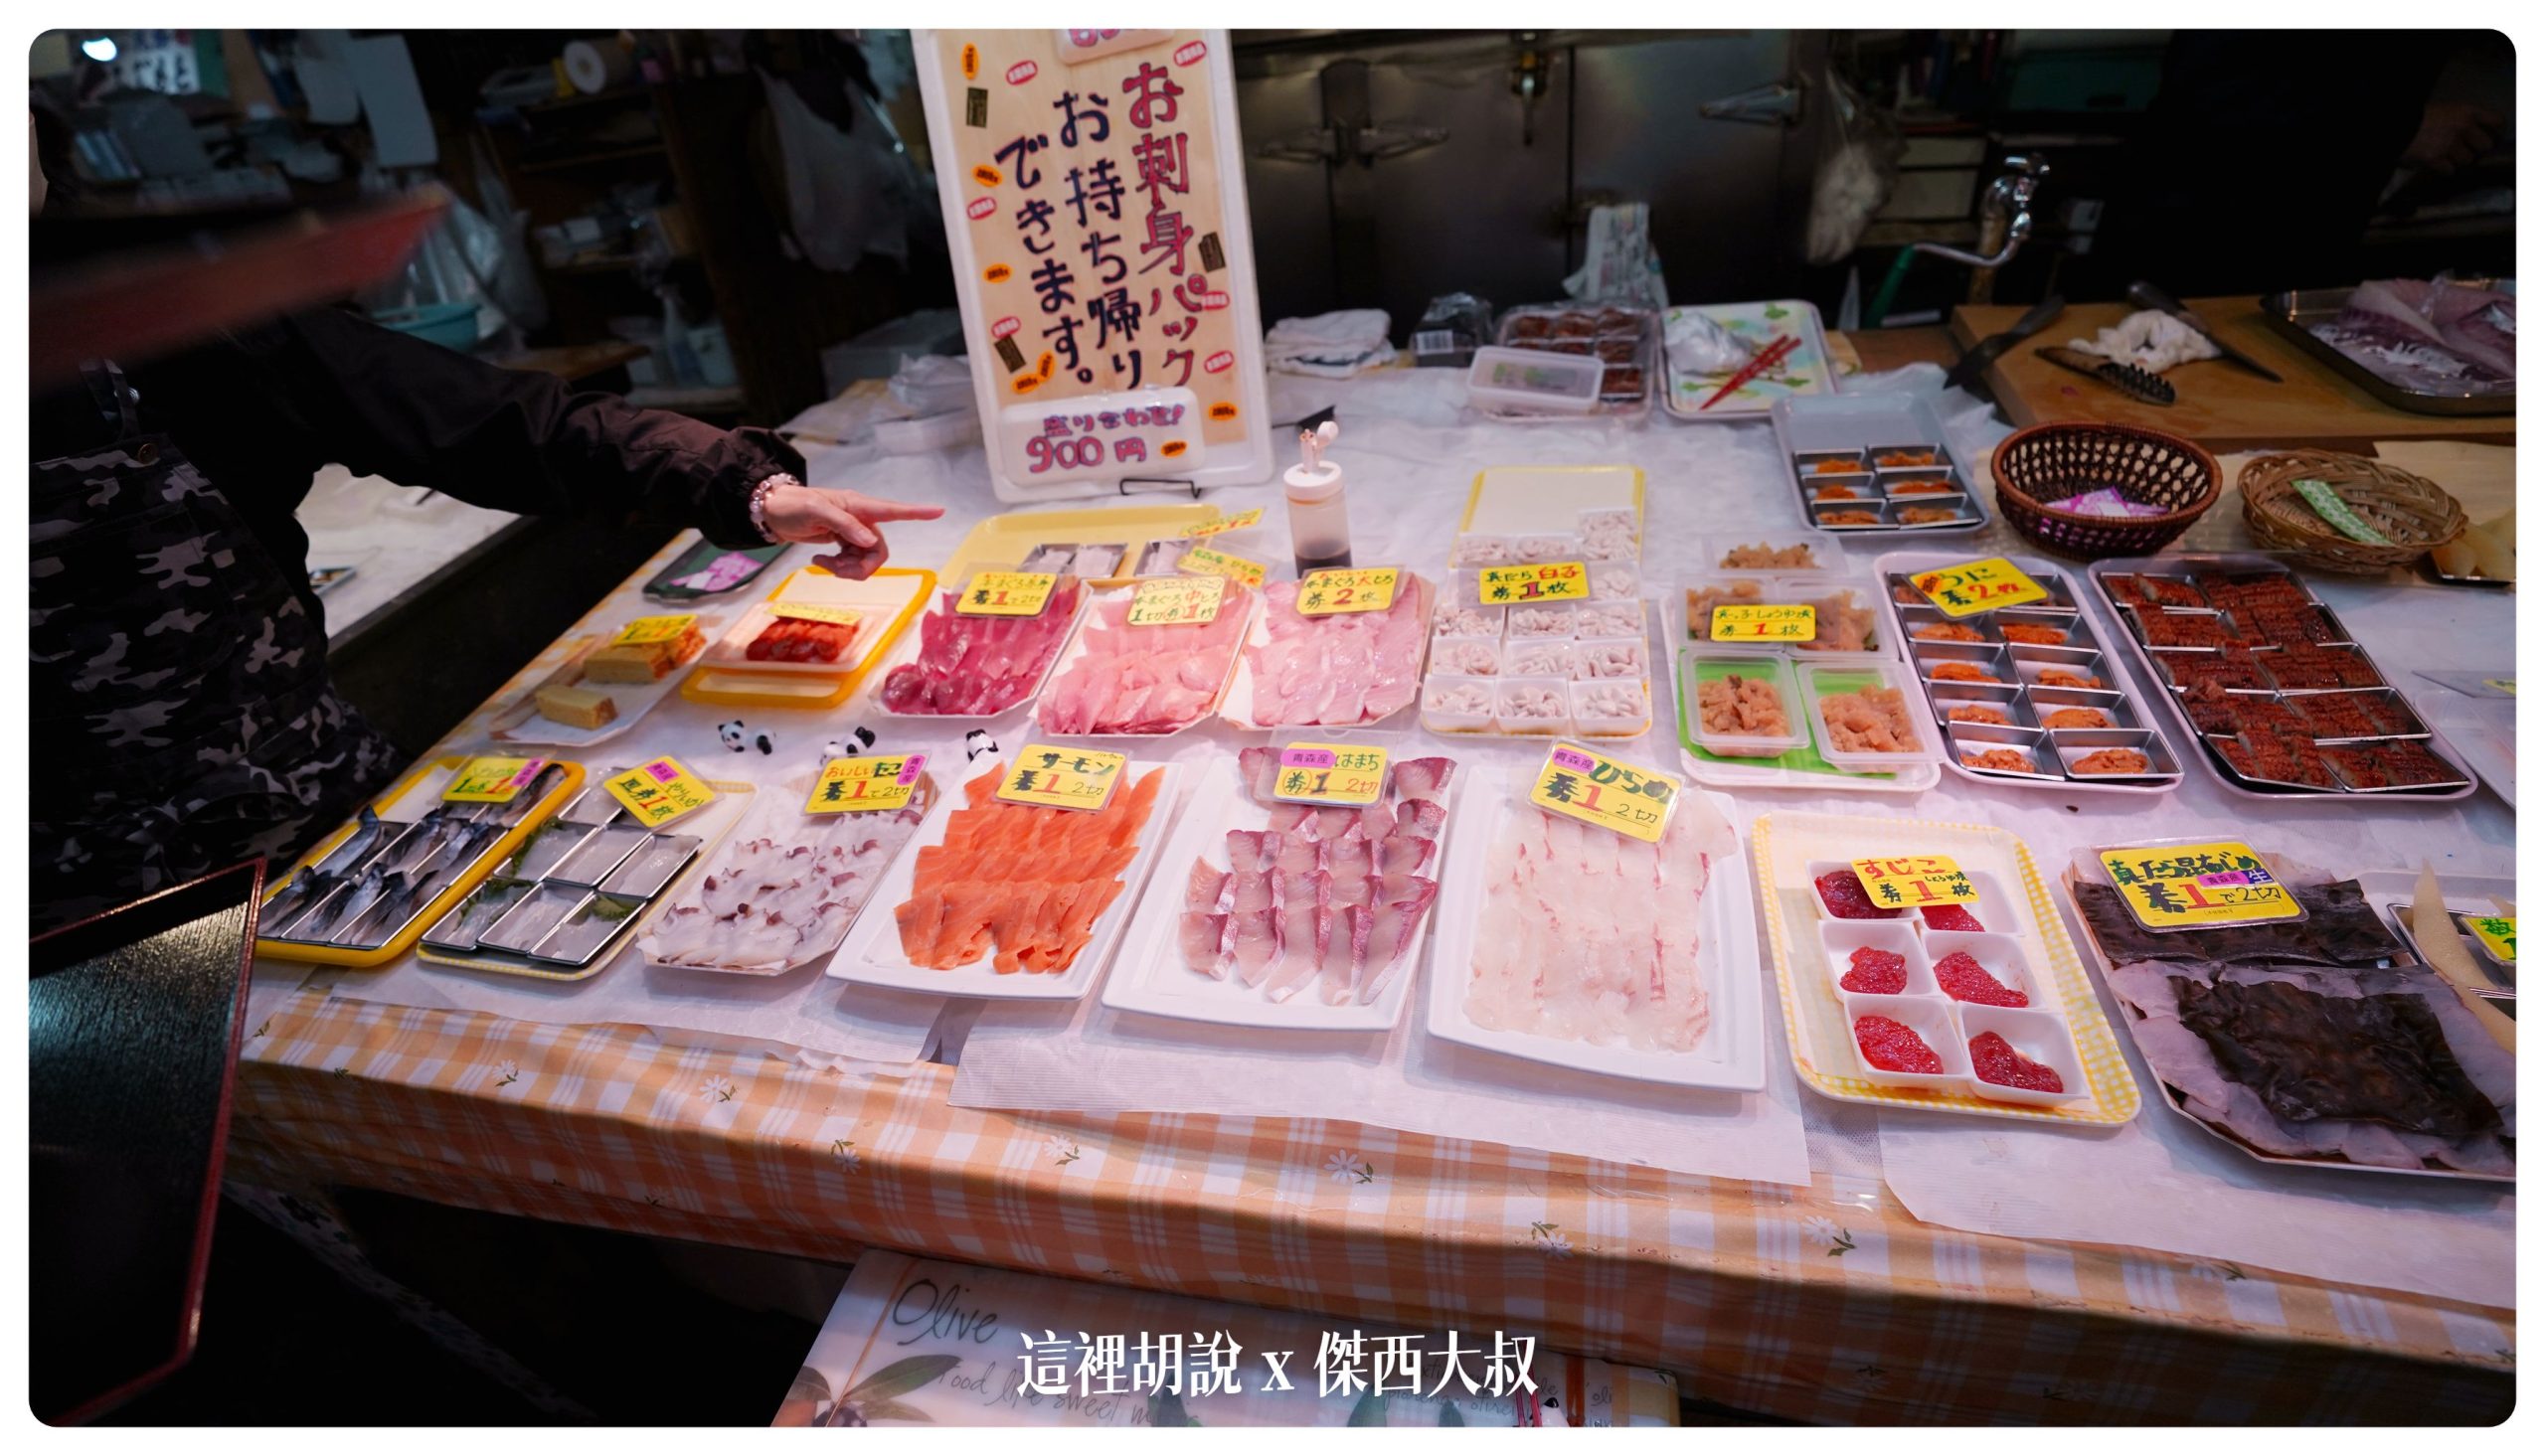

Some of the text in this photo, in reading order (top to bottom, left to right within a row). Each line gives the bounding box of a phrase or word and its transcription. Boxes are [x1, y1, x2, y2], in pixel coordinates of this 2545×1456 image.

[1054, 90, 1142, 390] お持ち帰り
[1121, 62, 1208, 388] お刺身パック
[995, 132, 1094, 385] できます。
[1940, 567, 1997, 586] うに
[1037, 752, 1116, 775] サーモン
[1334, 753, 1380, 771] はまち
[1589, 759, 1675, 804] ひらめ
[1857, 858, 1948, 881] すじこ
[2248, 869, 2274, 884] 生
[892, 1278, 1000, 1348] Olive
